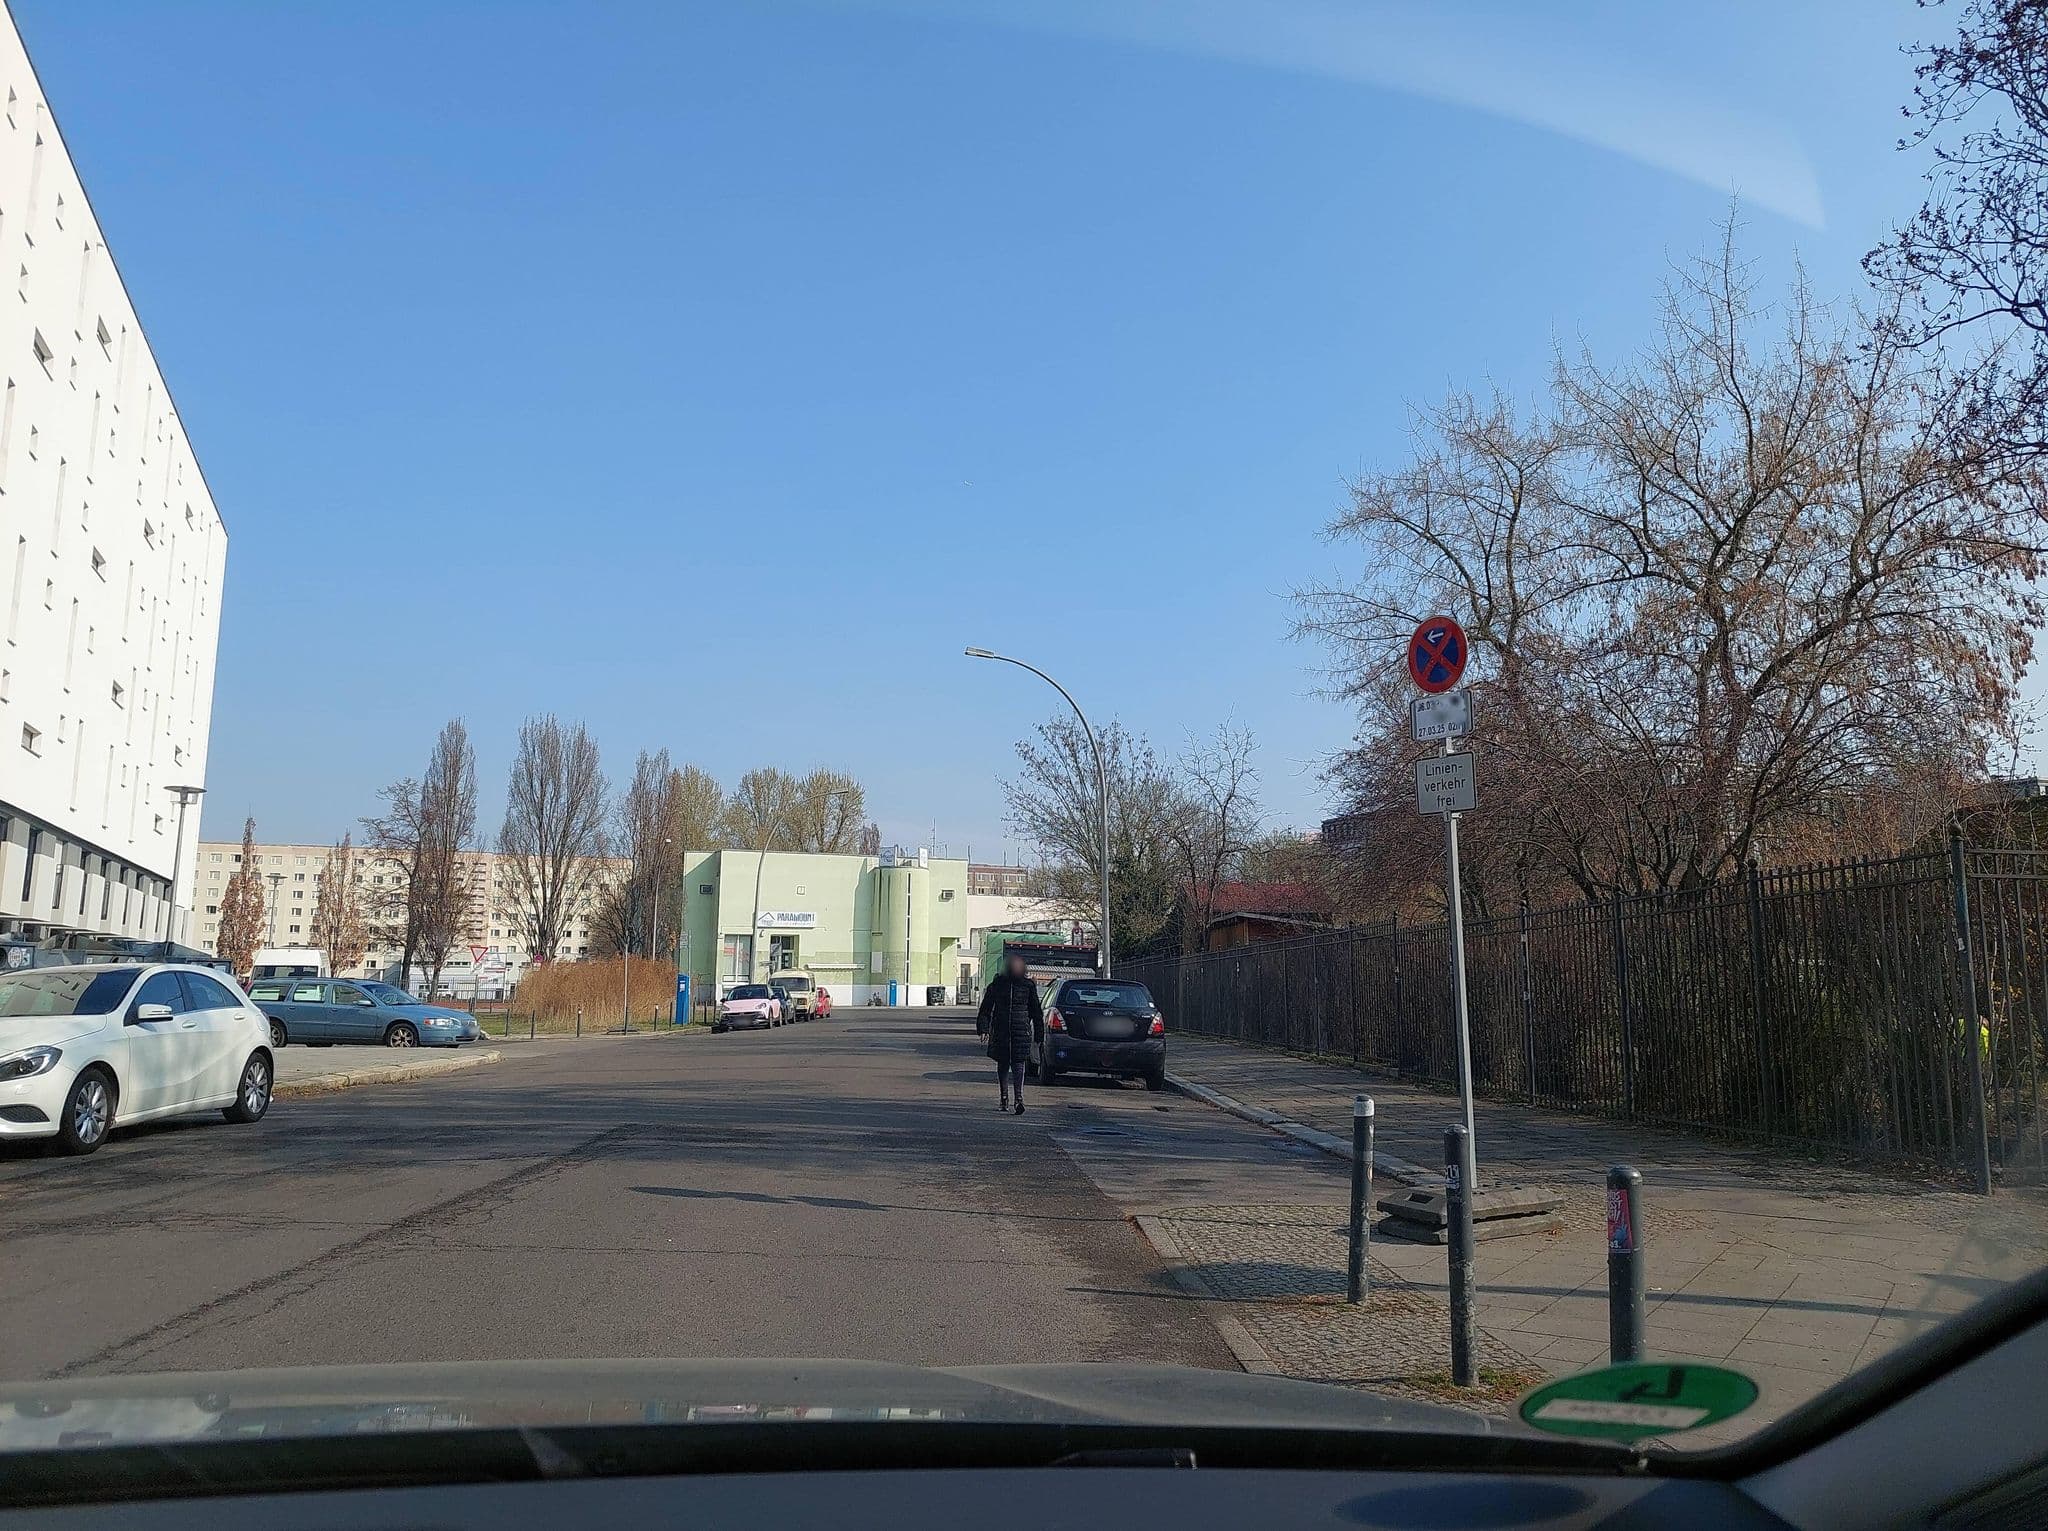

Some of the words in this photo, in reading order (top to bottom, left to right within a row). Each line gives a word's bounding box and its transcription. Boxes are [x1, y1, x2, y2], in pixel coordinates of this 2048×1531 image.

[1425, 763, 1463, 776] Linien-
[1424, 777, 1466, 792] verkehr
[1436, 793, 1456, 807] frei
